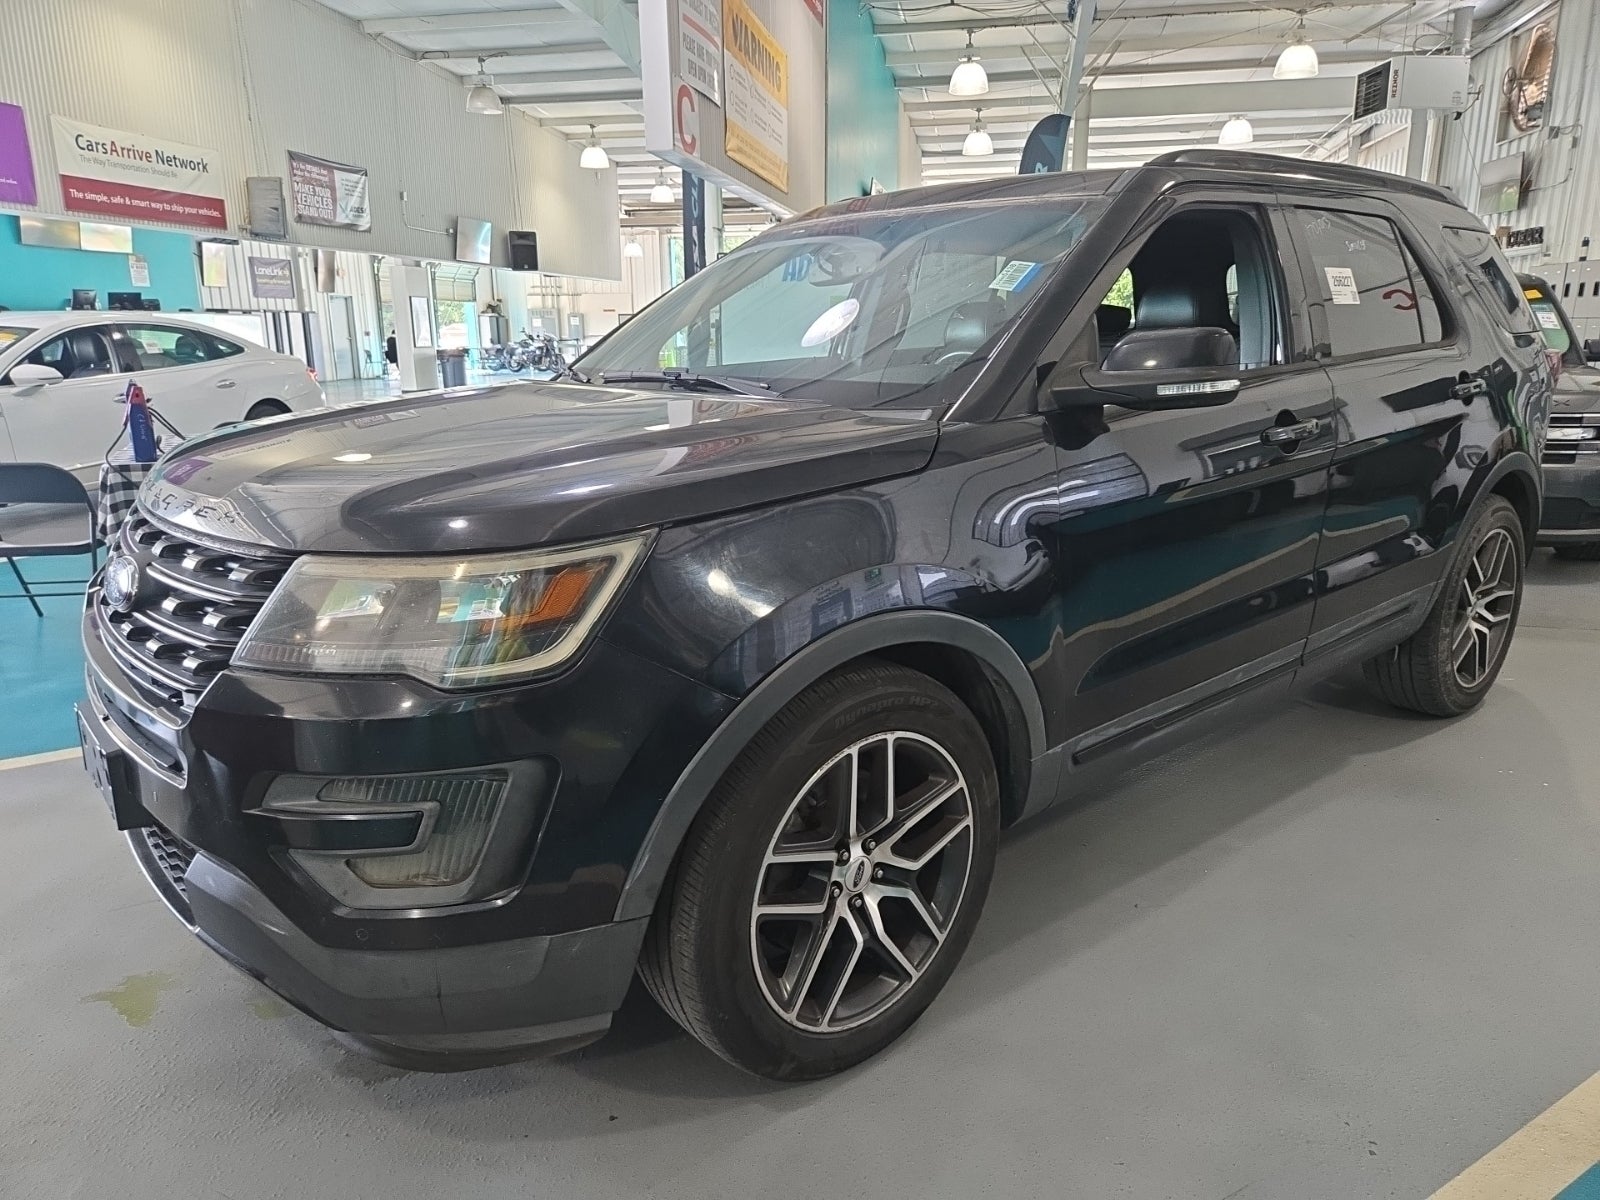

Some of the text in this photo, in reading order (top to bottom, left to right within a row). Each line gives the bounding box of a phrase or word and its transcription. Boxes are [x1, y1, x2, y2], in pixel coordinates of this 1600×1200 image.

[732, 11, 781, 93] WARNING
[676, 84, 696, 155] C
[75, 133, 209, 174] CarsArrive Network
[79, 154, 93, 165] The
[92, 157, 107, 168] Way
[106, 159, 150, 173] Transportation
[69, 188, 84, 199] The
[84, 191, 110, 204] simple,
[110, 195, 125, 204] safe
[125, 196, 131, 205] &
[131, 198, 150, 208] smart
[150, 201, 164, 211] way
[171, 203, 184, 214] ship
[184, 206, 199, 214] your
[294, 182, 314, 195] MAKE
[314, 185, 331, 198] YOUR
[295, 192, 333, 209] VEHICLES
[297, 204, 318, 217] STAND
